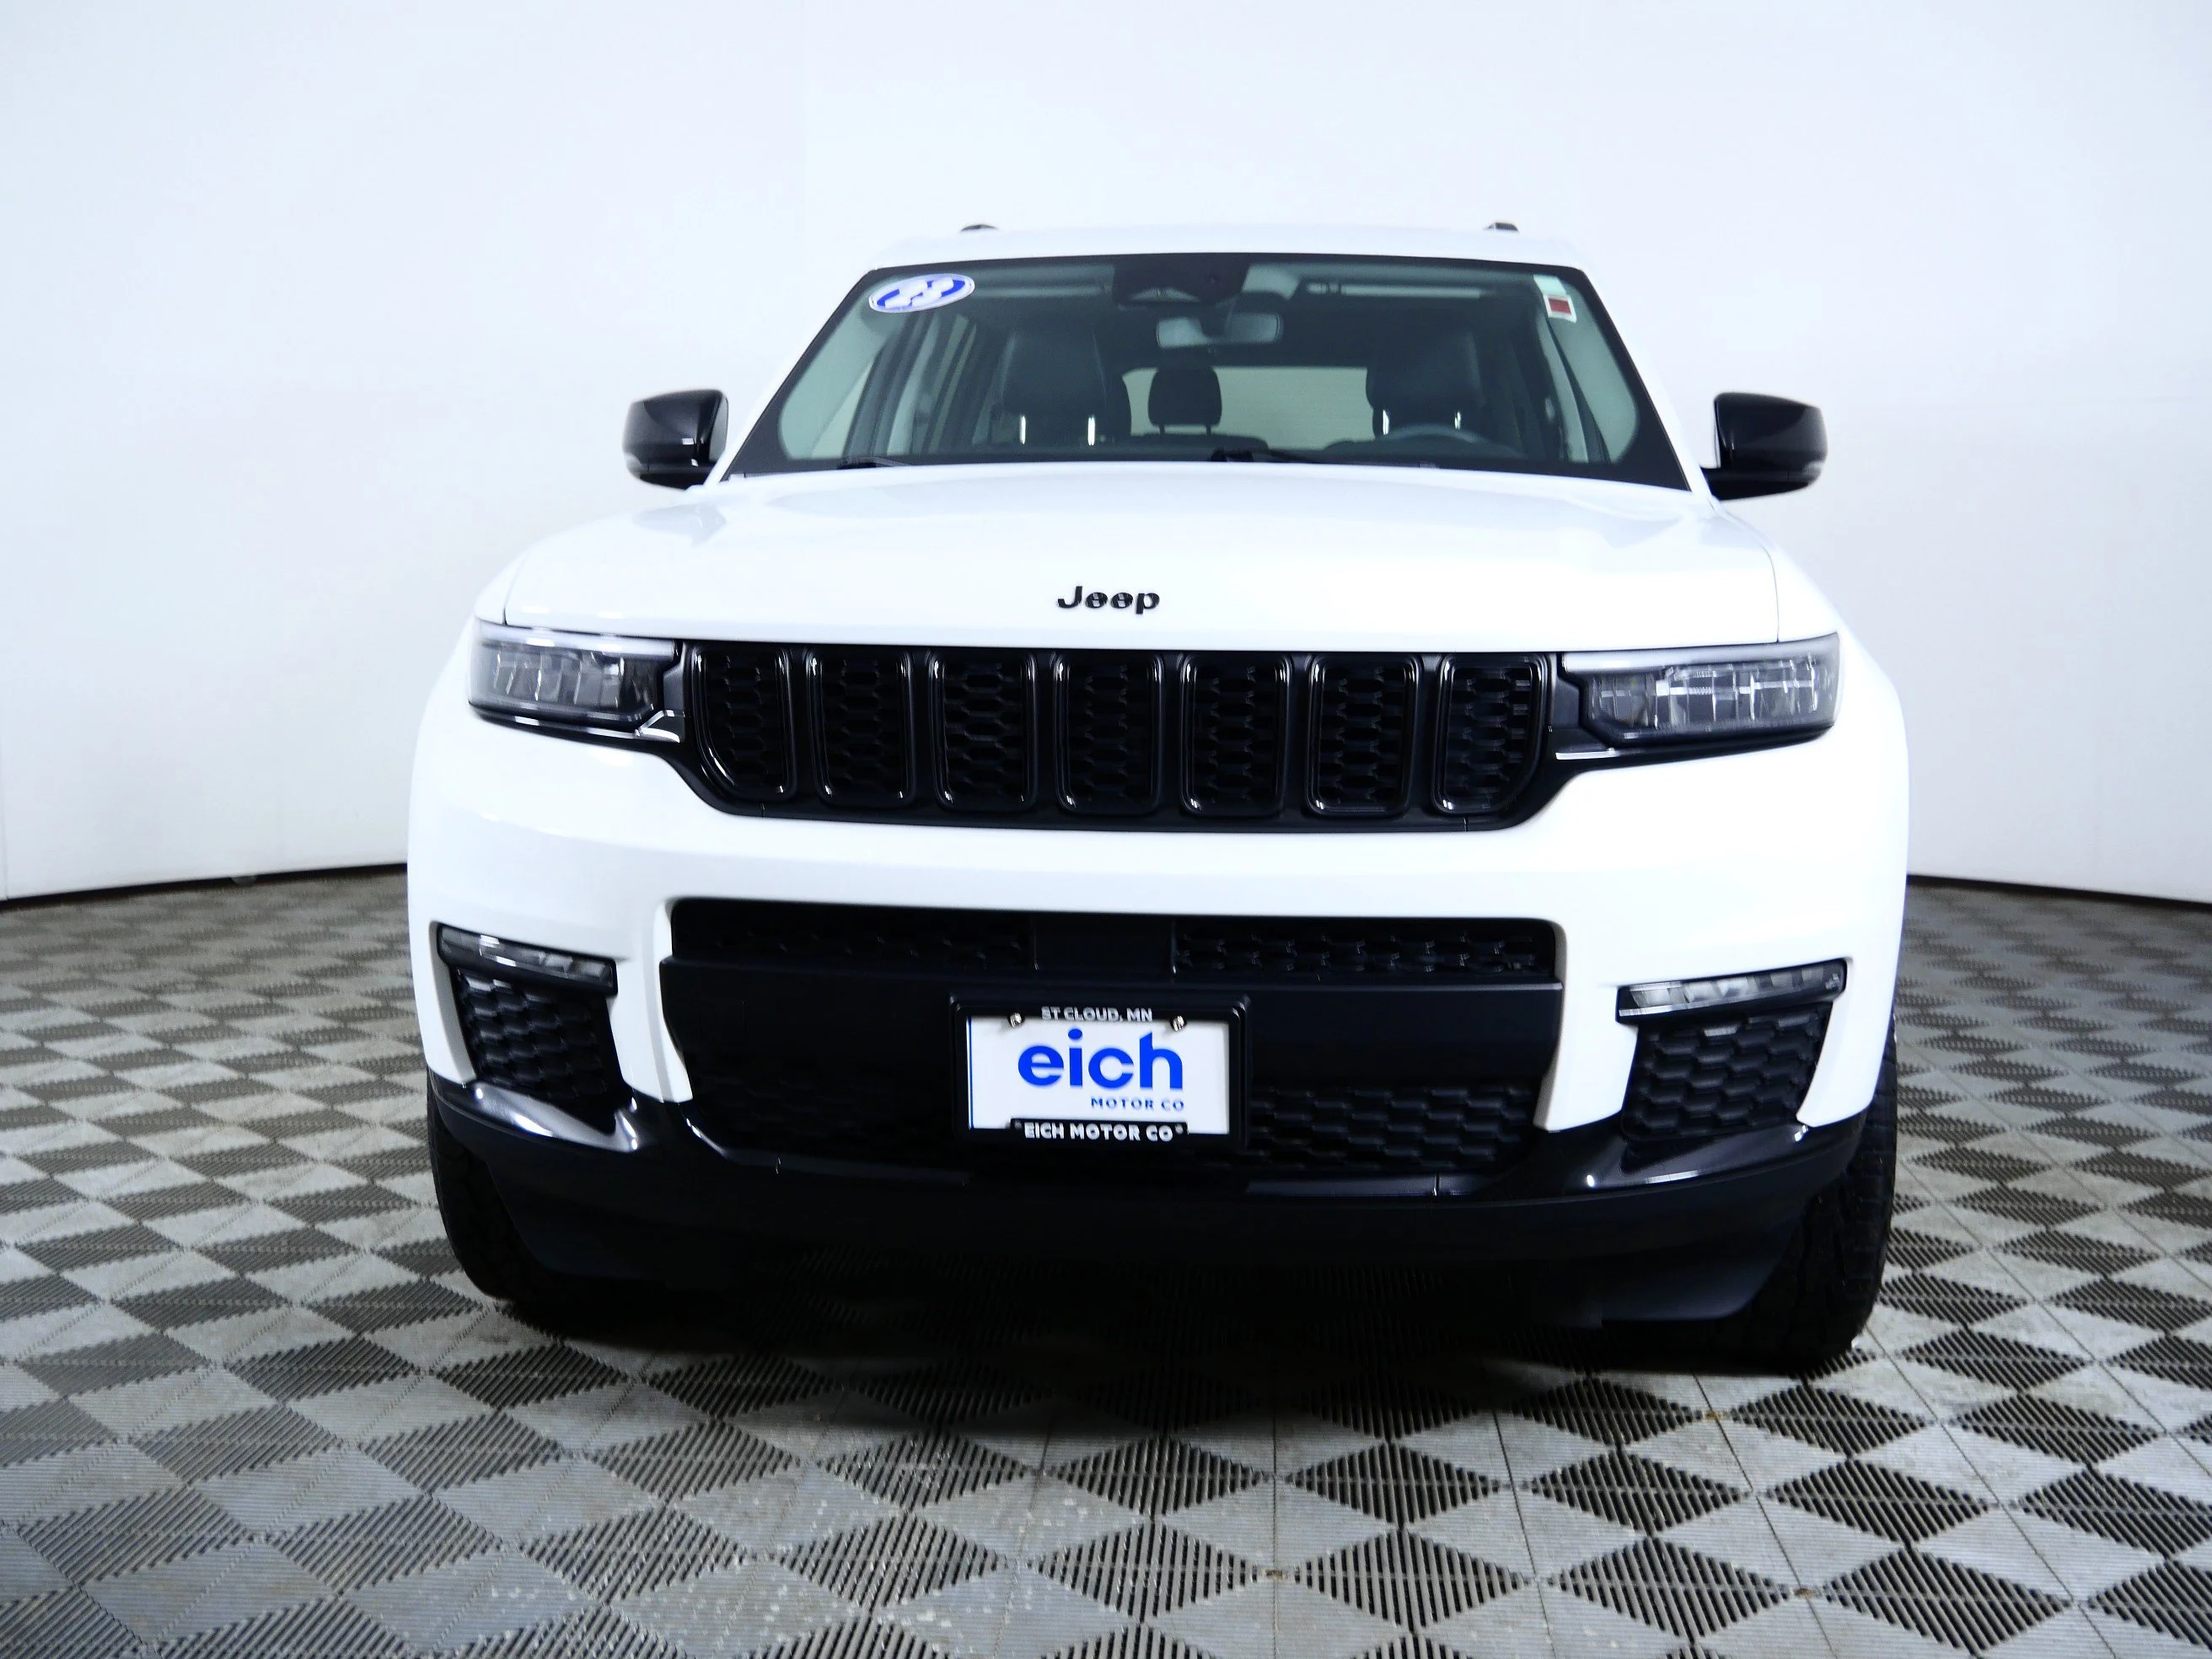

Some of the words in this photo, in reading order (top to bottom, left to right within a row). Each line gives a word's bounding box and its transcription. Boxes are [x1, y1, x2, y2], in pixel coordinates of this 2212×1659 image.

[1057, 586, 1160, 615] Jeep
[1041, 1007, 1061, 1021] ST
[1126, 1008, 1152, 1023] MN
[1017, 1028, 1184, 1090] eich
[1091, 1097, 1154, 1110] MOTOR
[1161, 1099, 1184, 1111] CO
[1024, 1122, 1064, 1139] EICH
[1070, 1123, 1141, 1141] MOTOR
[1146, 1125, 1173, 1142] CO
